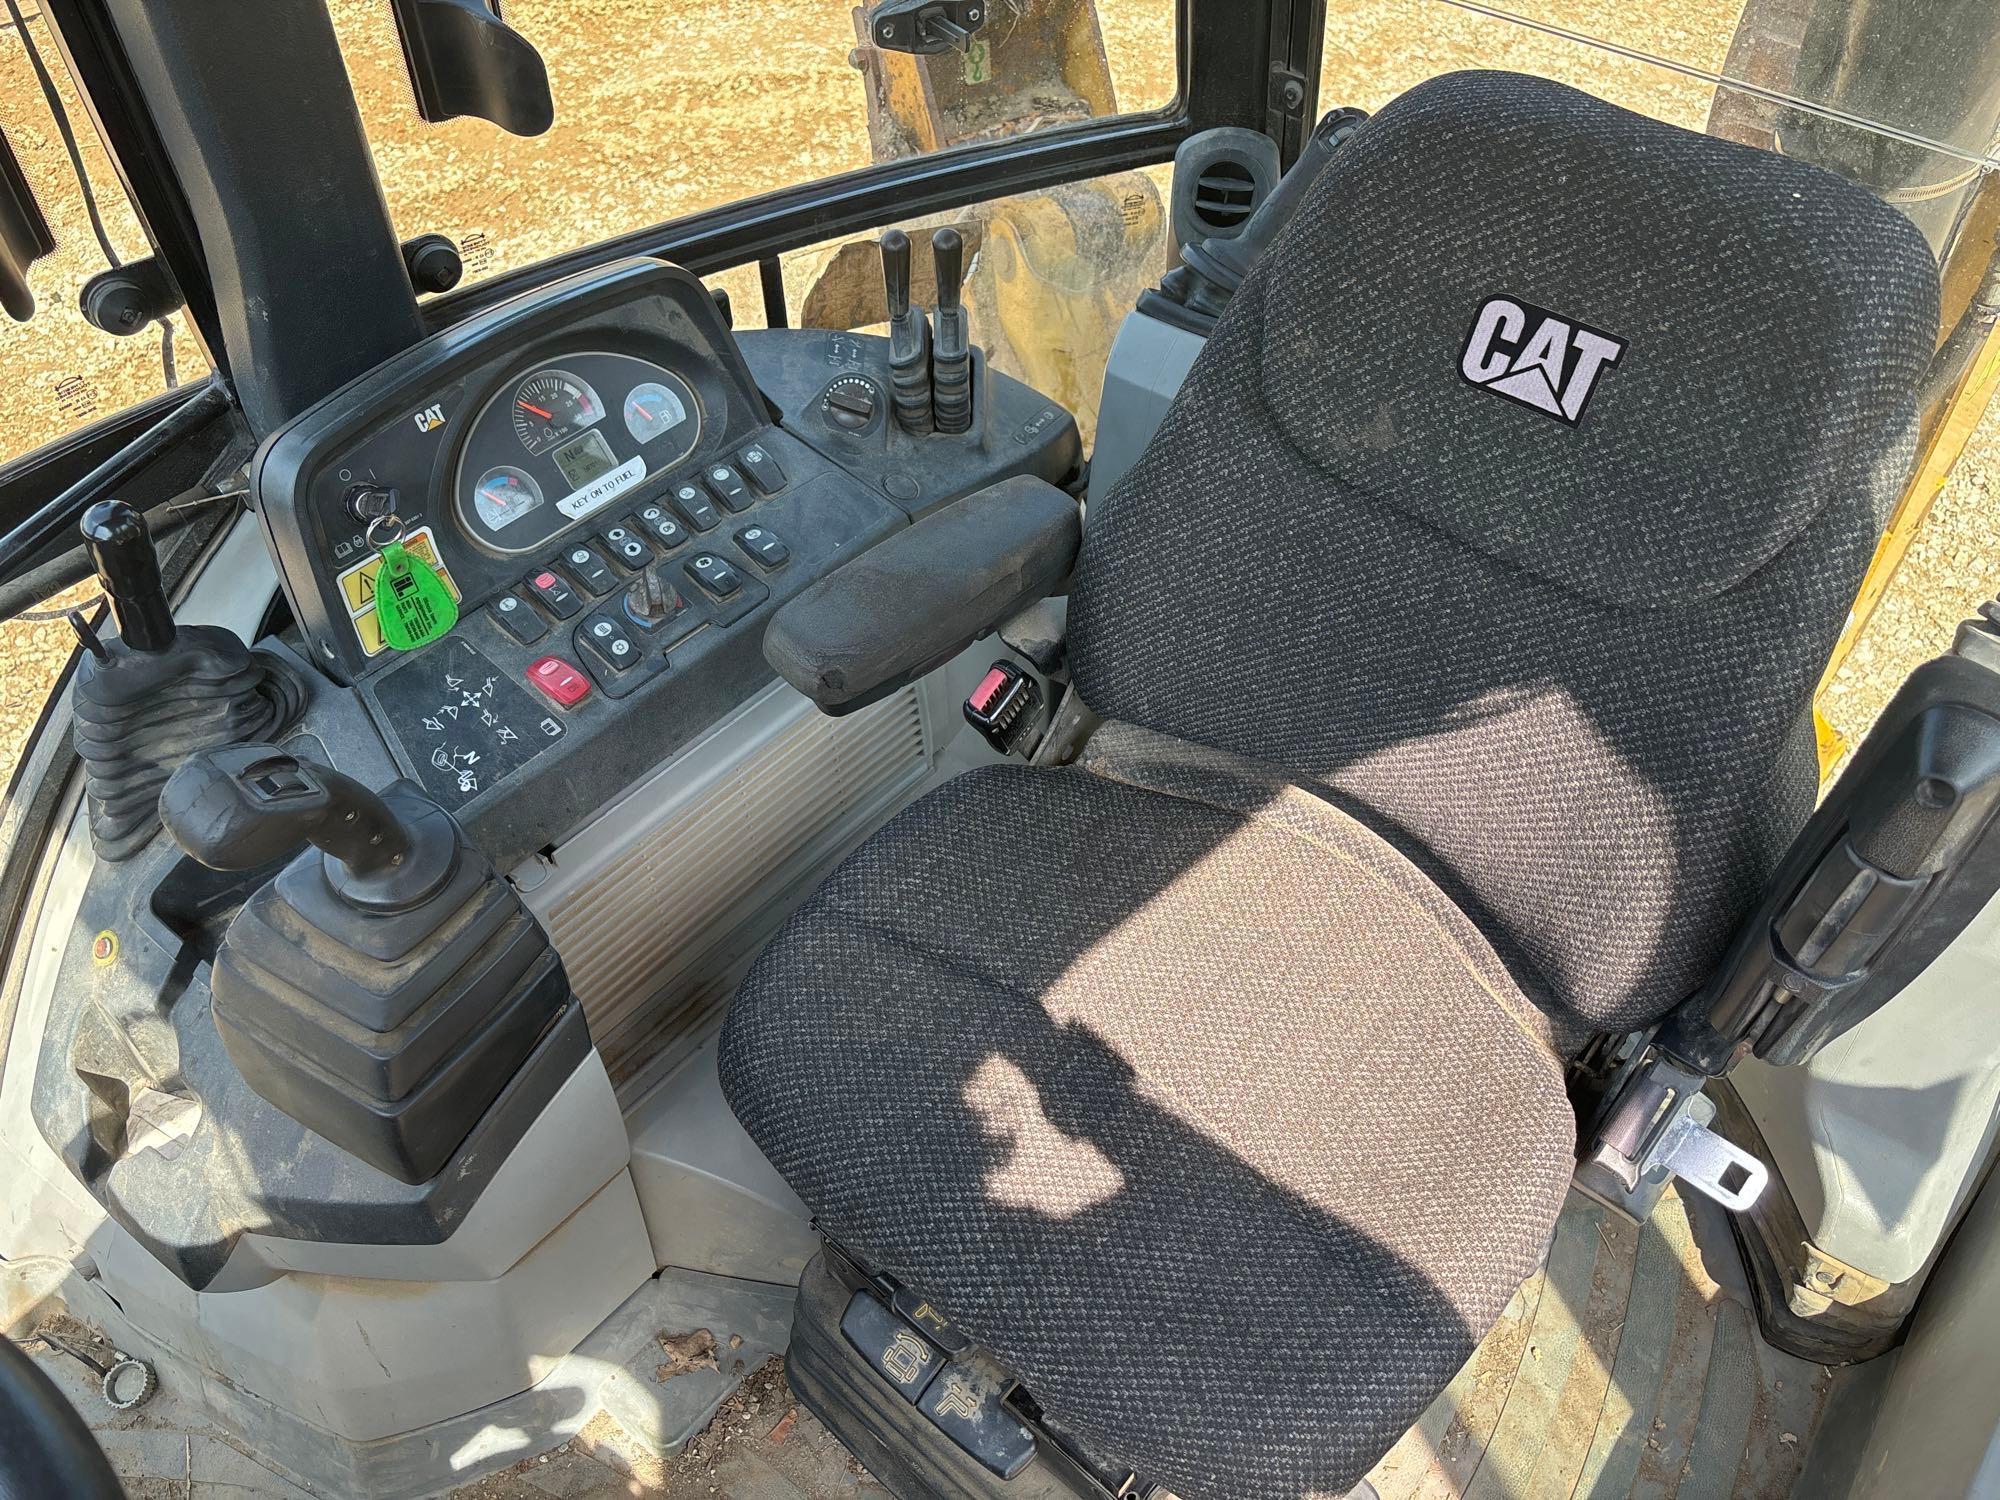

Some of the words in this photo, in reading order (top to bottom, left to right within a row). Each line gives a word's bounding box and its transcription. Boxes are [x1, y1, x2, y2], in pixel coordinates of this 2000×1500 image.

[1462, 299, 1621, 421] CAT
[414, 403, 446, 432] CAT
[563, 449, 576, 462] N
[571, 495, 590, 510] KEY
[590, 488, 603, 499] ON
[603, 480, 615, 492] TO
[615, 470, 636, 485] FUEL
[663, 524, 674, 532] OK
